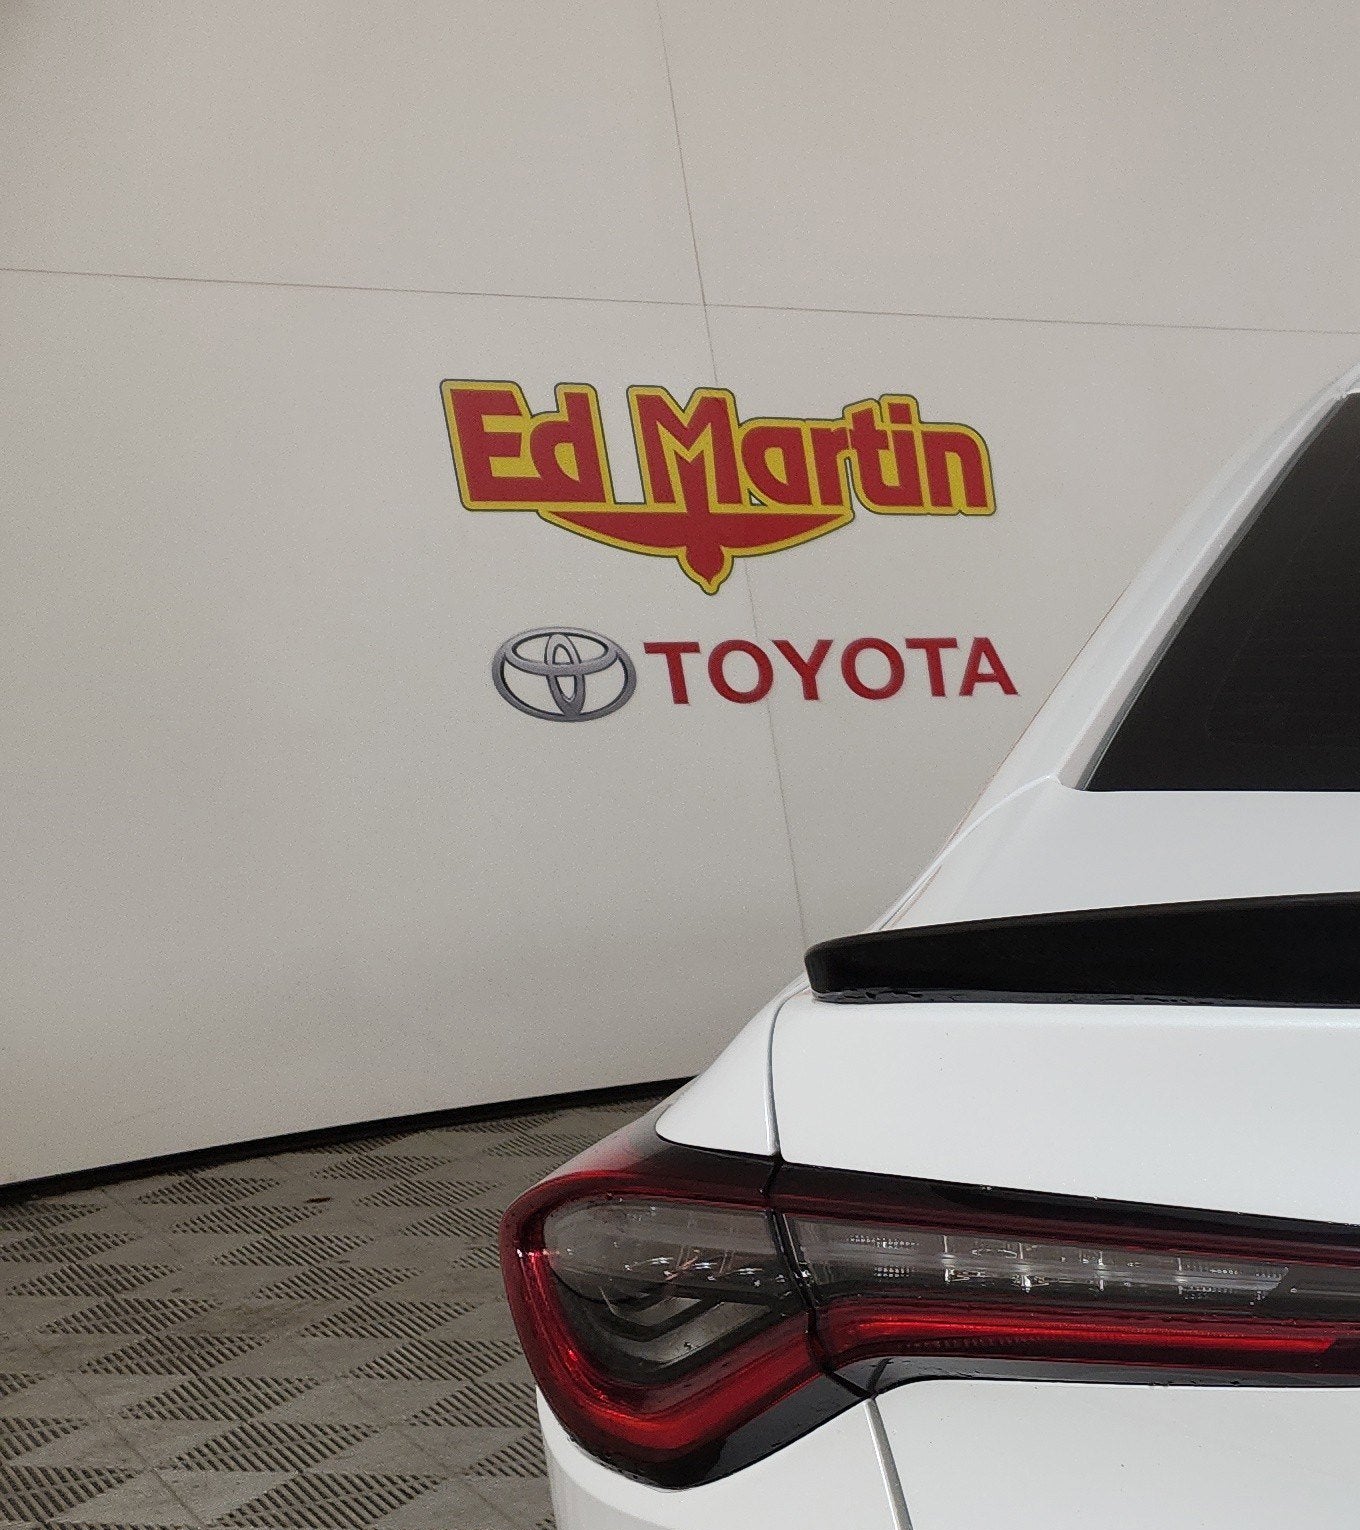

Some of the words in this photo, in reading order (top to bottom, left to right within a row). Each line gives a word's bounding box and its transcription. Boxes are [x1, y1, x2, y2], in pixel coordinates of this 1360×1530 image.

[440, 380, 614, 511] Ed
[627, 387, 997, 516] Martin
[643, 636, 1018, 705] TOYOTA
